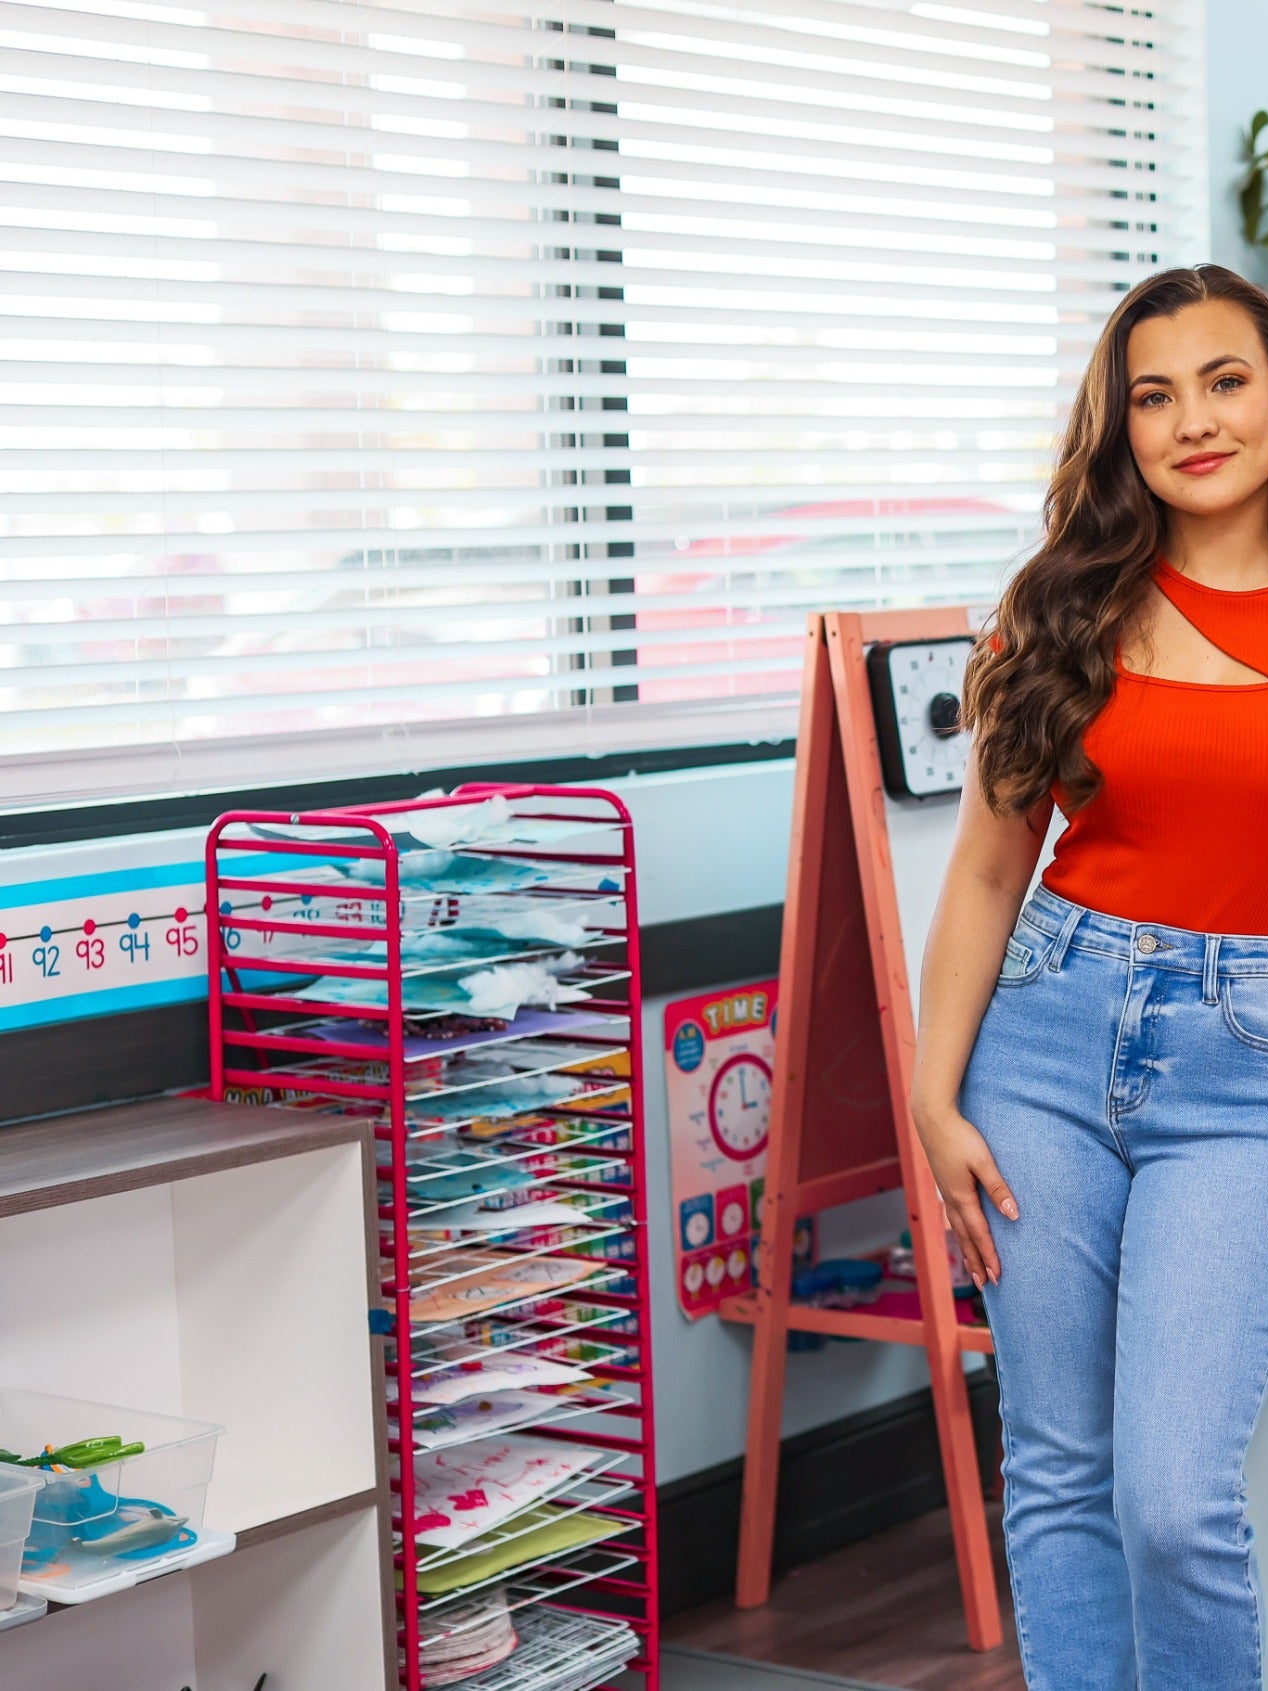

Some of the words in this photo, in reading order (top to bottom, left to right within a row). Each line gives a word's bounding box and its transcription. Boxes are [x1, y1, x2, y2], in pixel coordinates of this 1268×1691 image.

[32, 945, 60, 978] 92
[75, 938, 105, 970] 93
[119, 932, 150, 963] 94
[165, 925, 199, 957] 95
[703, 993, 767, 1034] TIME
